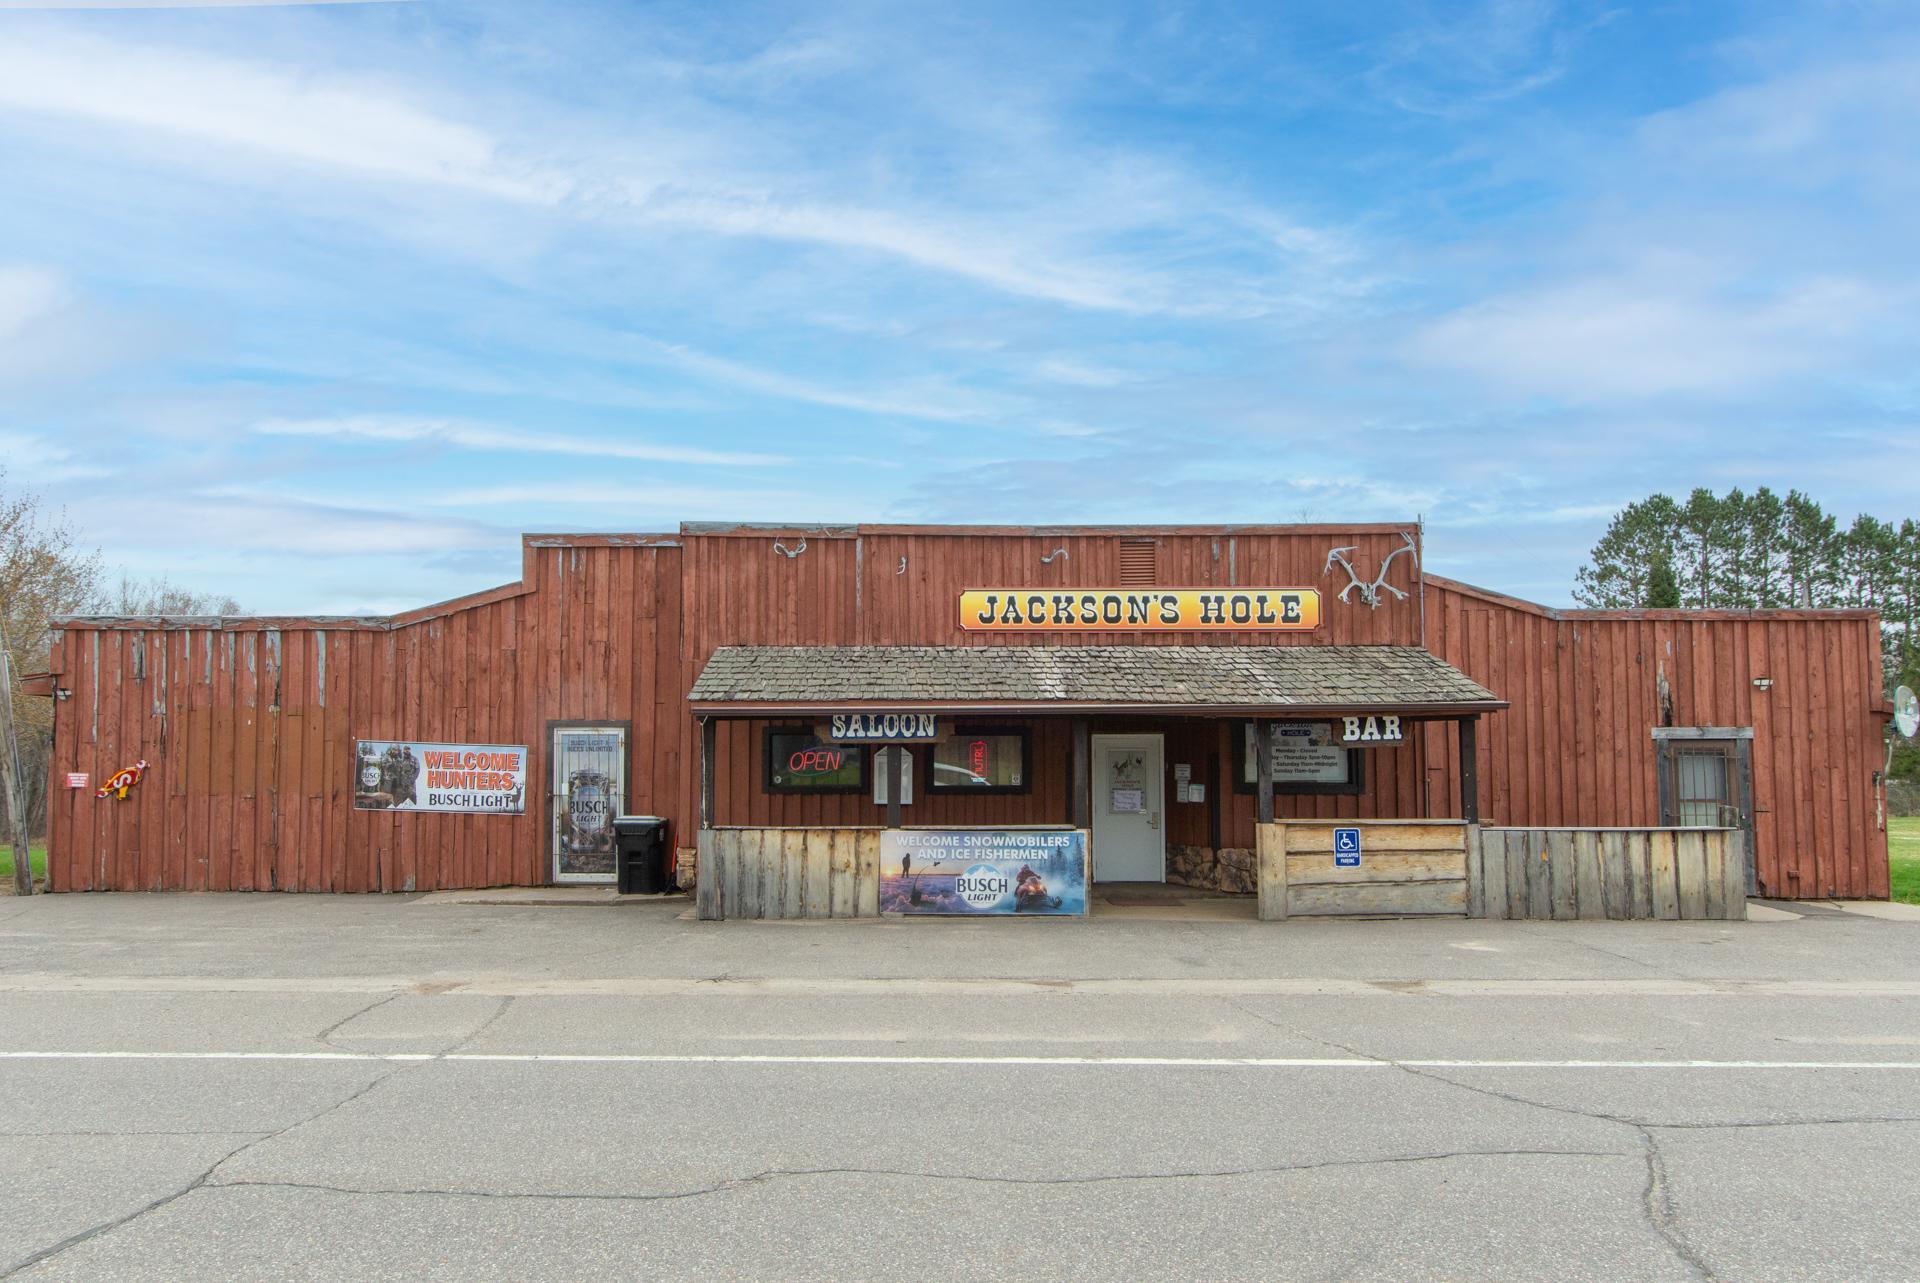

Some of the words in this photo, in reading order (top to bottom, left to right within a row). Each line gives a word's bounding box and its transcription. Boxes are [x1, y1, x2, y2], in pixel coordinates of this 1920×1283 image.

[977, 594, 1181, 625] JACKSON'S
[1199, 594, 1302, 625] HOLE
[832, 714, 937, 738] SALOON
[1342, 715, 1402, 741] BAR
[424, 751, 520, 772] WELCOME
[789, 751, 841, 771] OPEN
[426, 770, 515, 791] HUNTERS
[429, 793, 471, 807] BUSCH
[473, 794, 512, 808] LIGHT
[570, 800, 609, 815] BUSCH
[576, 815, 601, 823] LIGHT
[895, 835, 960, 848] WELCOME
[963, 835, 1071, 848] SNOWMOBILERS
[917, 849, 947, 860] AND
[951, 849, 972, 860] ICE
[974, 849, 1049, 860] FISHERMEN
[956, 878, 1008, 893] BUSCH
[967, 893, 998, 901] LIGHT
